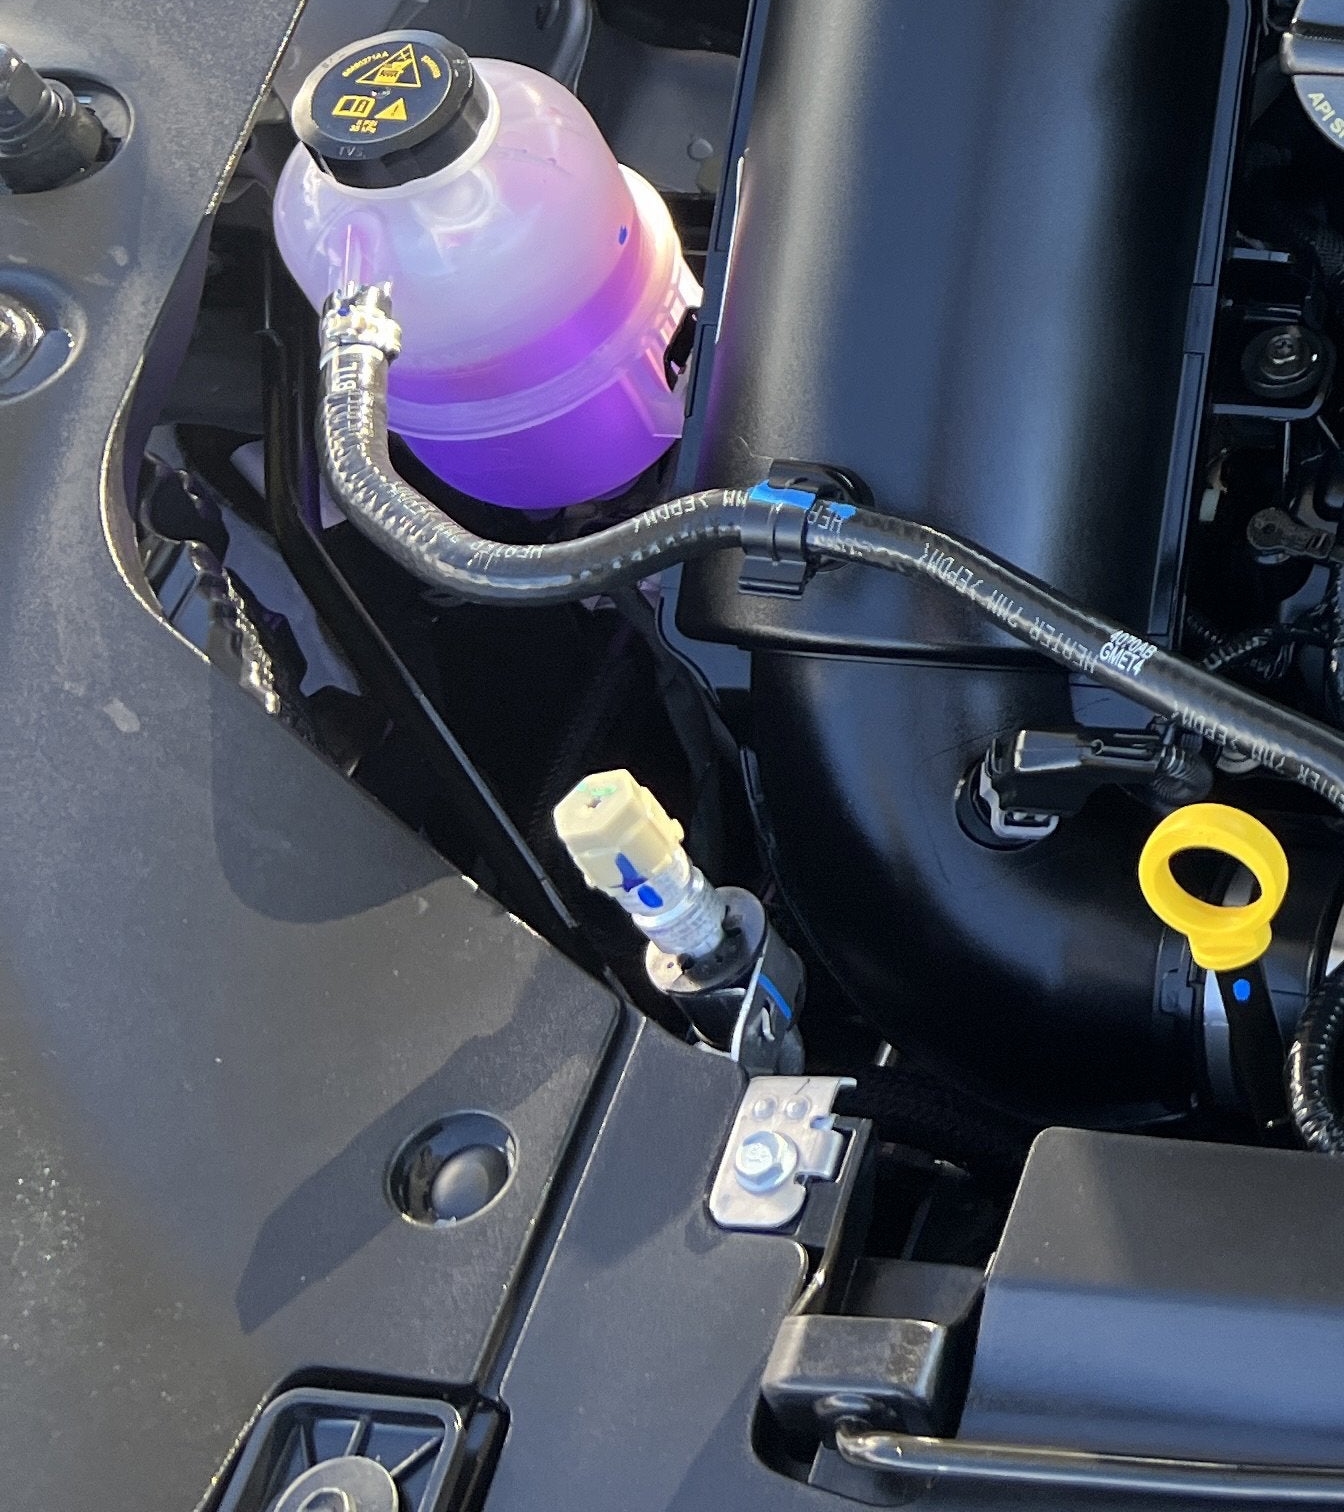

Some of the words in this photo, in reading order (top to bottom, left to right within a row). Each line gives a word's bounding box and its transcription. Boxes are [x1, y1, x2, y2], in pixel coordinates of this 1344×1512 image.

[1306, 90, 1337, 123] API
[1029, 615, 1100, 676] HEATER
[1098, 640, 1145, 678] GMET4
